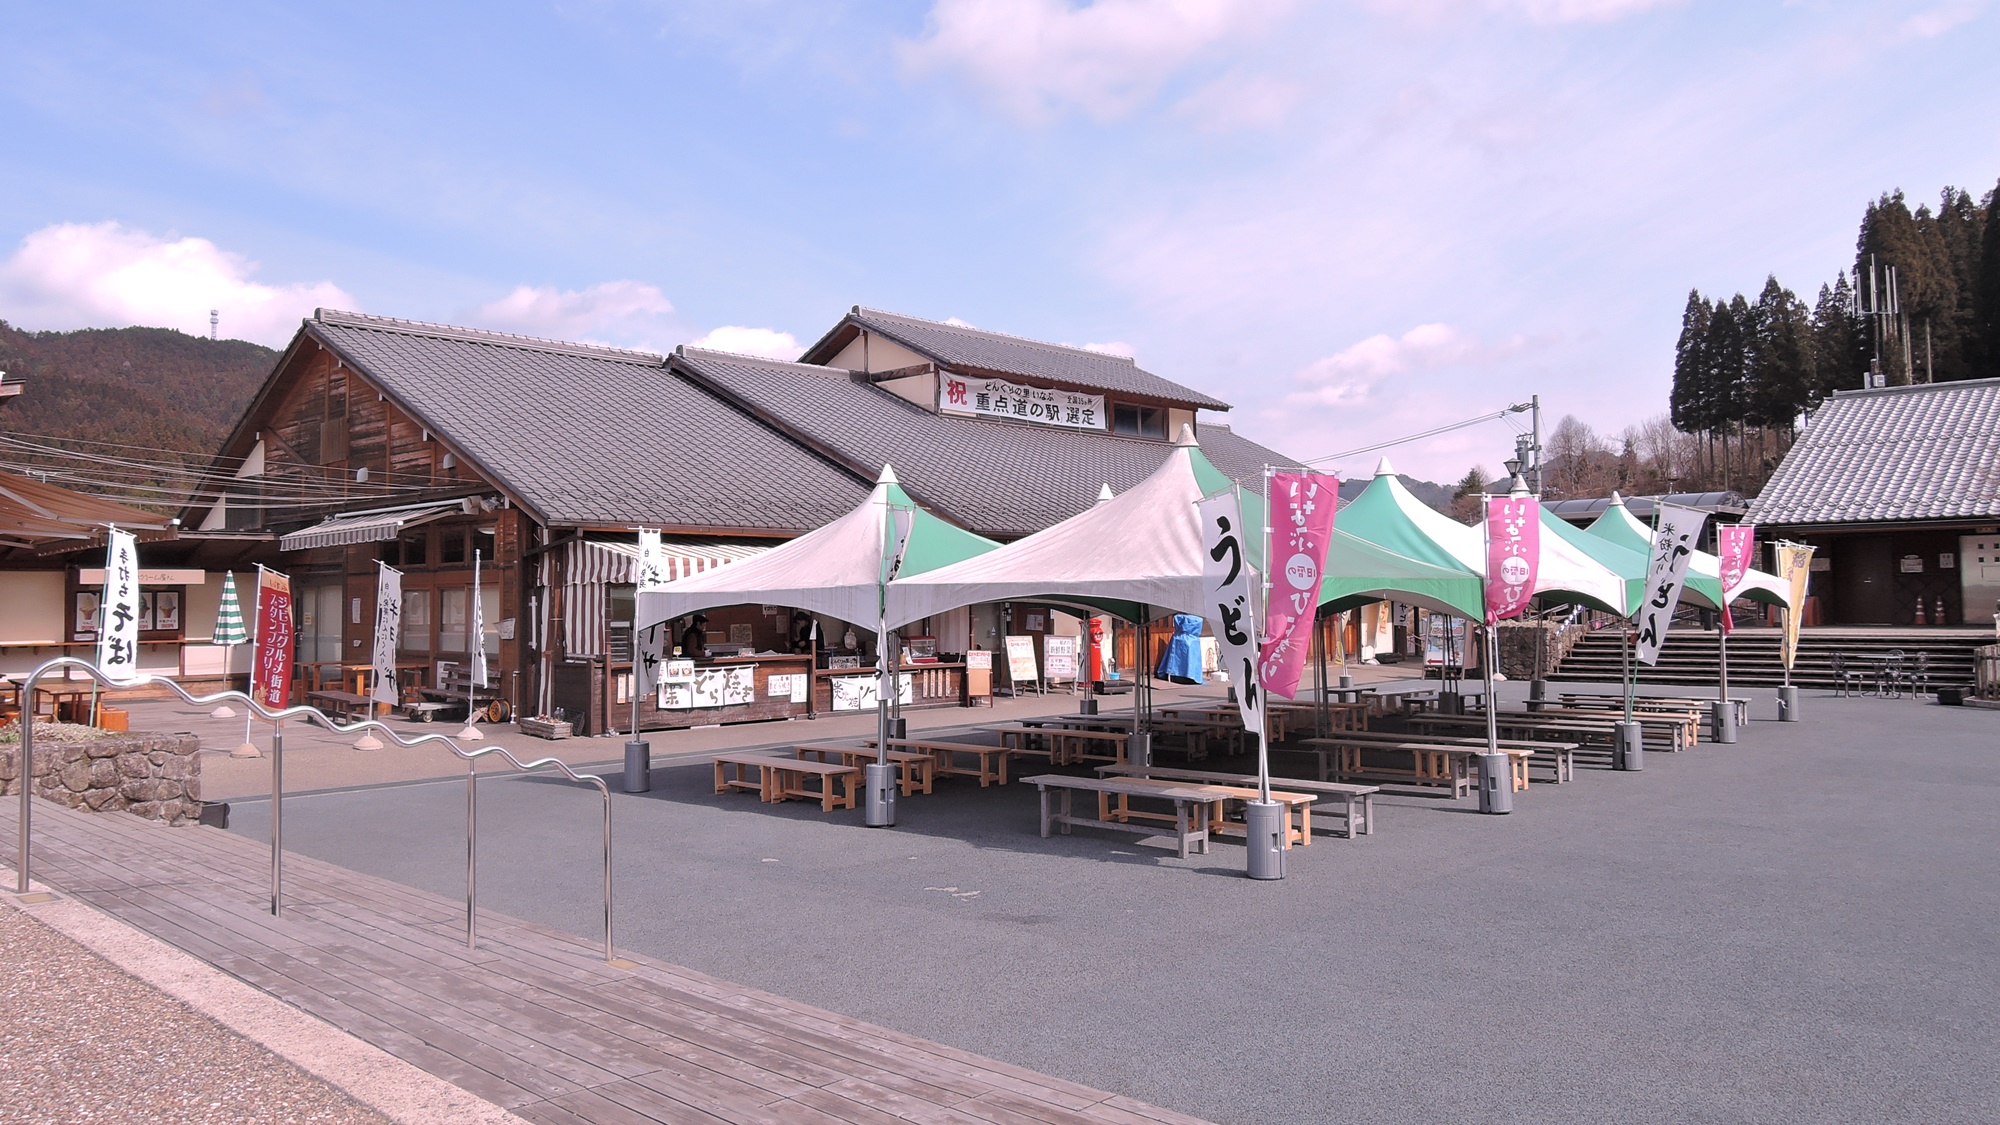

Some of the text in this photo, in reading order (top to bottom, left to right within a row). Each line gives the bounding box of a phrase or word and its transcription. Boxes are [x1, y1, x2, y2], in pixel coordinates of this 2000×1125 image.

[947, 380, 967, 406] 祝
[984, 381, 1055, 402] どんぐりの里 いなぶ
[1065, 406, 1096, 426] 選定
[1209, 515, 1260, 711] うどん
[268, 595, 289, 703] ジビエグルメ街道
